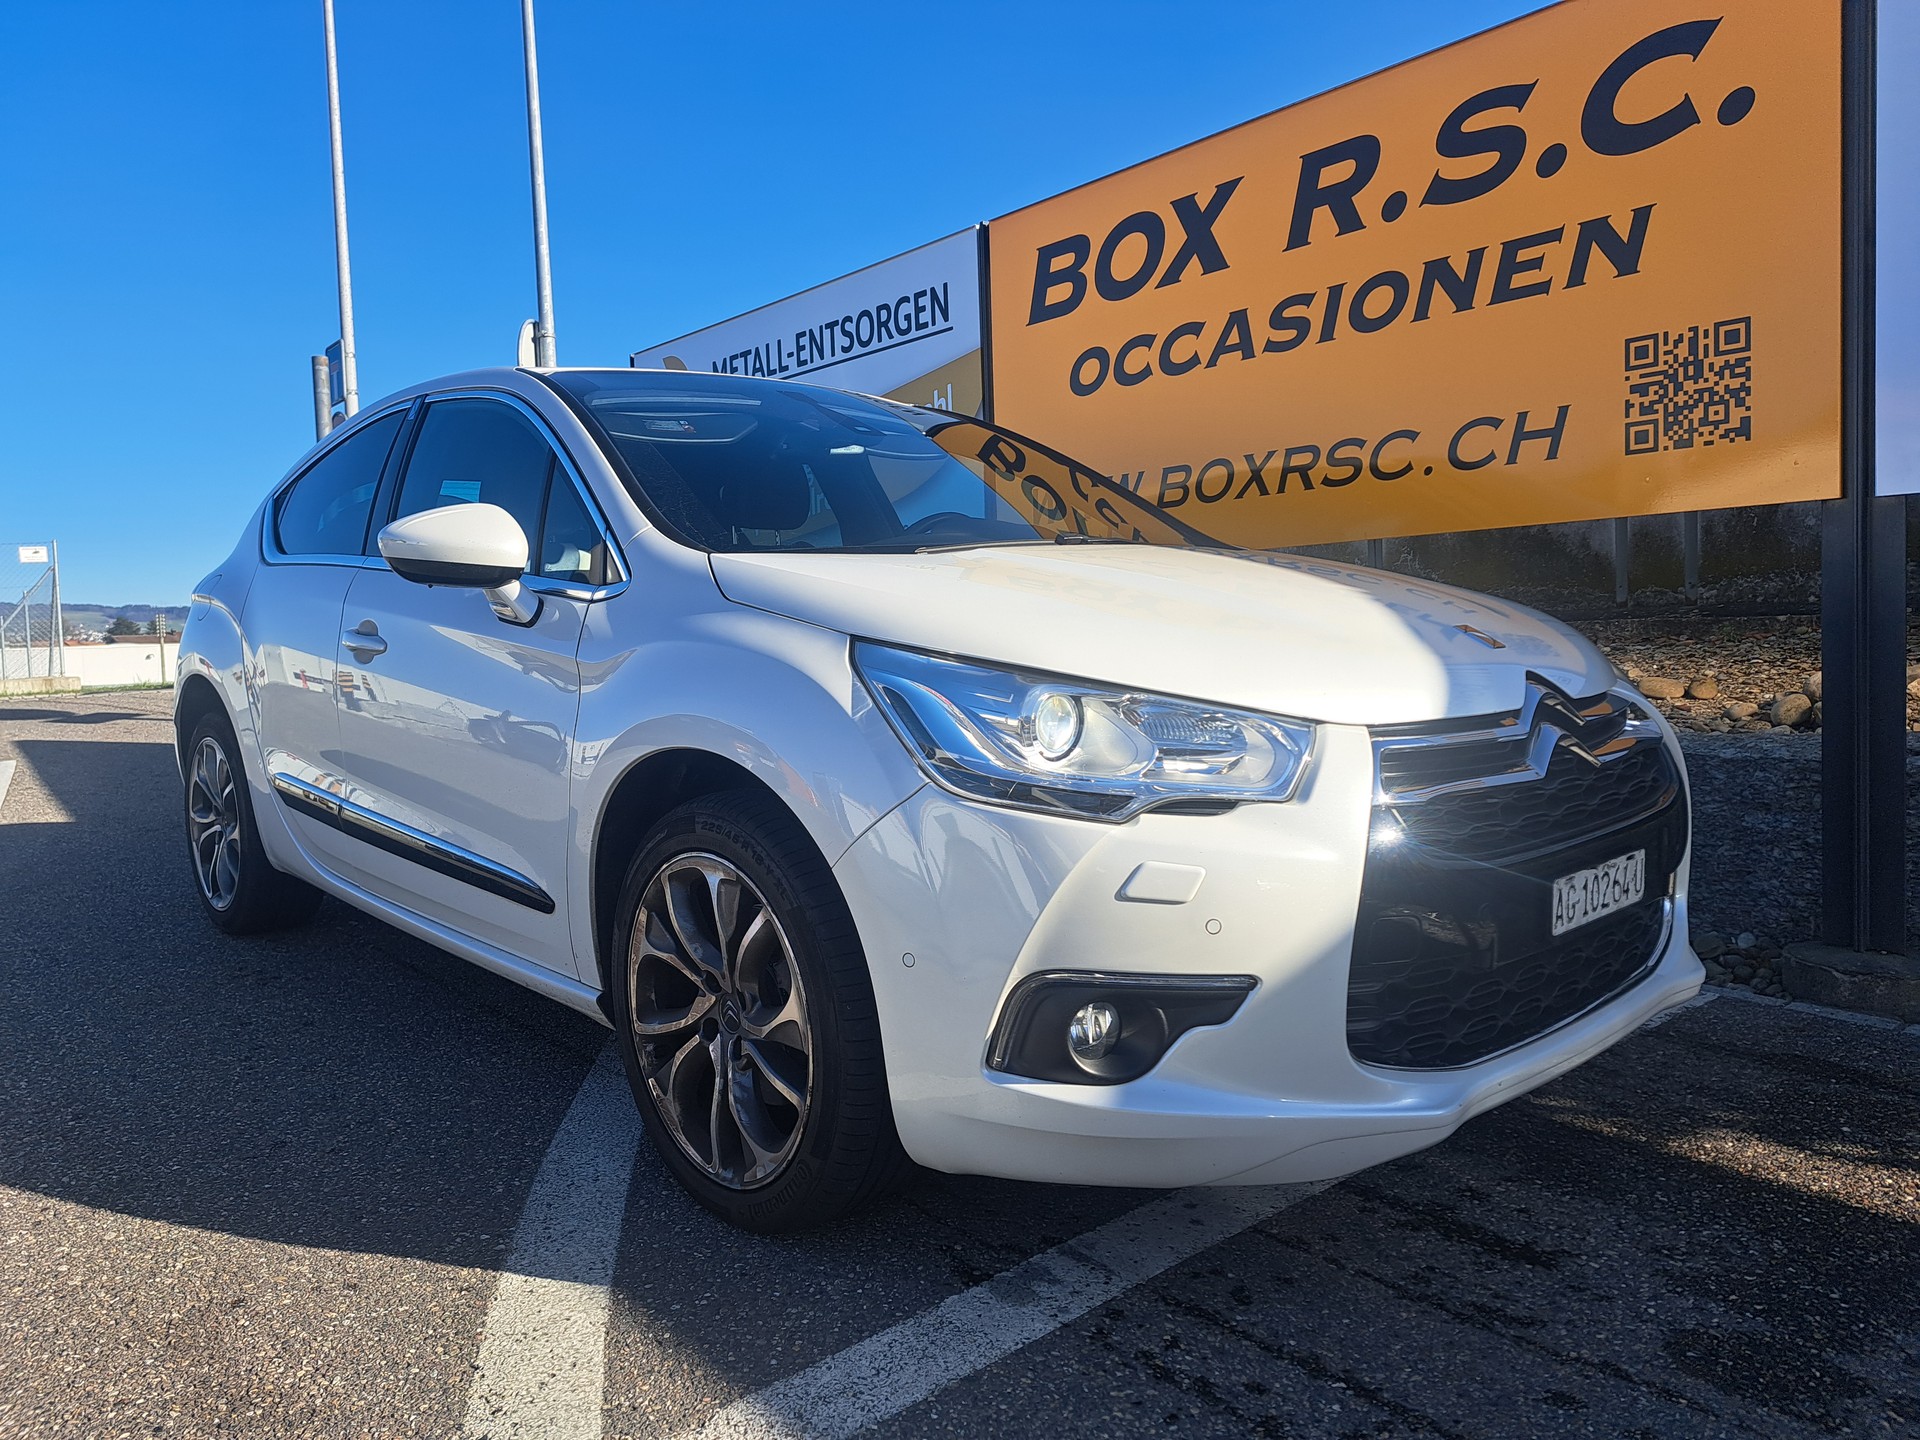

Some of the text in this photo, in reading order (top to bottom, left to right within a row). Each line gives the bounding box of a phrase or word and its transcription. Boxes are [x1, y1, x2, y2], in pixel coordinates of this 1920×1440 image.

[1025, 15, 1757, 327] BOX R.S.C.
[1069, 202, 1658, 397] OCCASIONEN
